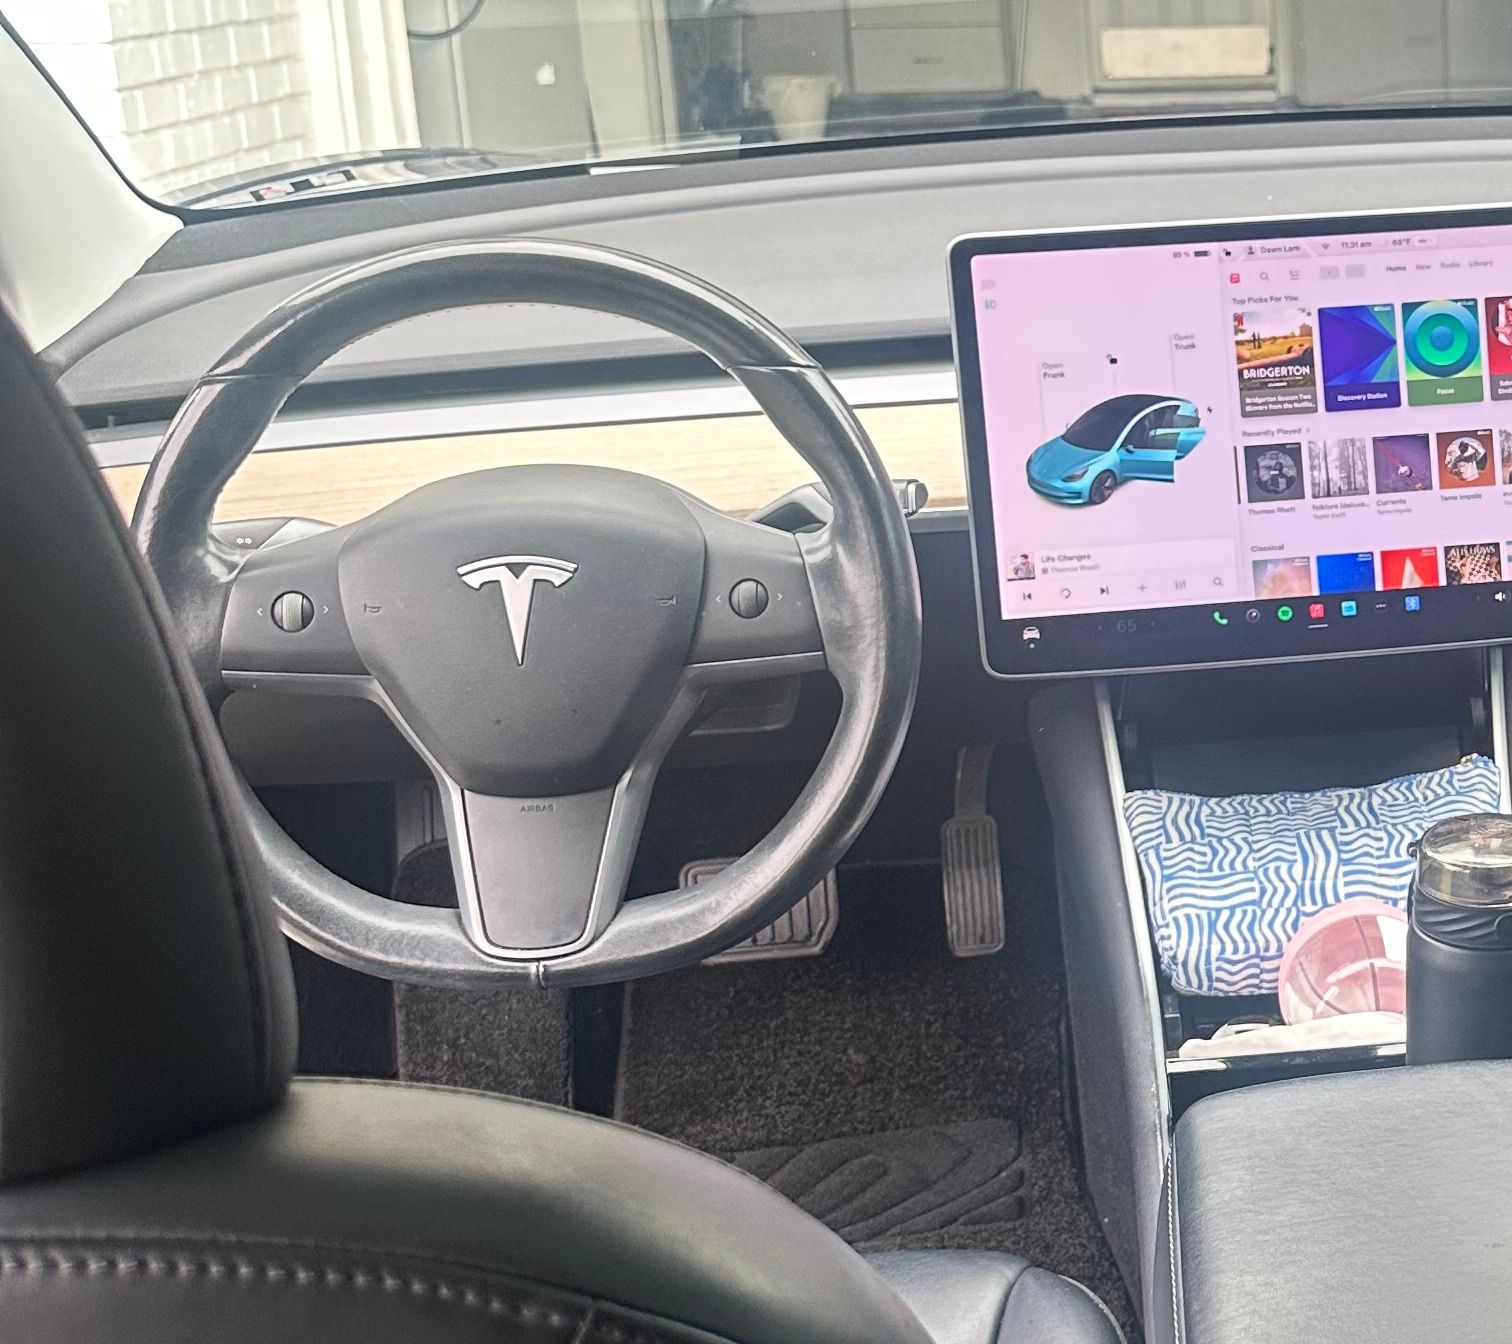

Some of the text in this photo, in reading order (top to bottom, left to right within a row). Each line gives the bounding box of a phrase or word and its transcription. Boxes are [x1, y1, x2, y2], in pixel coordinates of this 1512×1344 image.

[1232, 297, 1246, 305] Top
[1243, 365, 1311, 380] BRIDGERTON
[1242, 428, 1301, 438] Recently Played
[1250, 543, 1285, 553] Classical
[1041, 554, 1091, 564] Life Changes
[1117, 619, 1137, 633] 65
